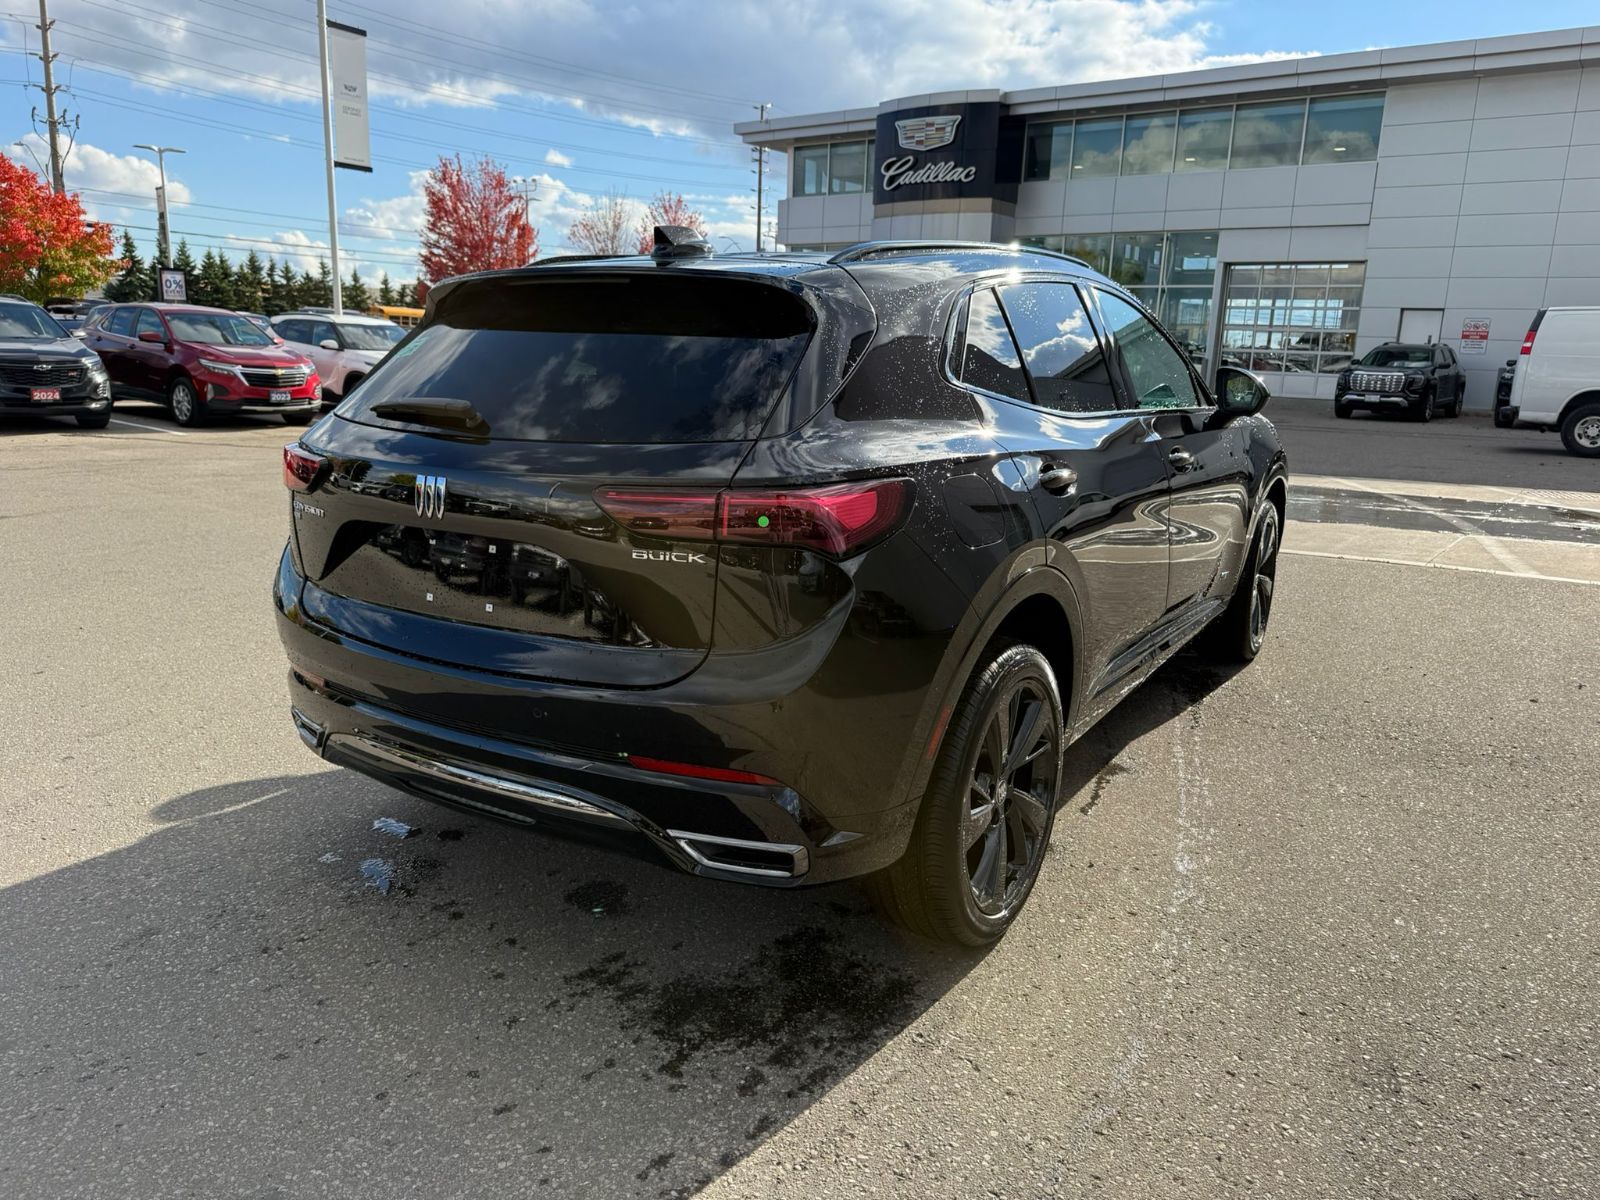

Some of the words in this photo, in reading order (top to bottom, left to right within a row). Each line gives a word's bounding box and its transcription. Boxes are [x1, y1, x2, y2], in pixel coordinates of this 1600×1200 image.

[881, 155, 976, 191] Cadillac
[165, 279, 184, 290] 0%
[33, 391, 60, 400] 2024
[631, 549, 707, 564] BUICK
